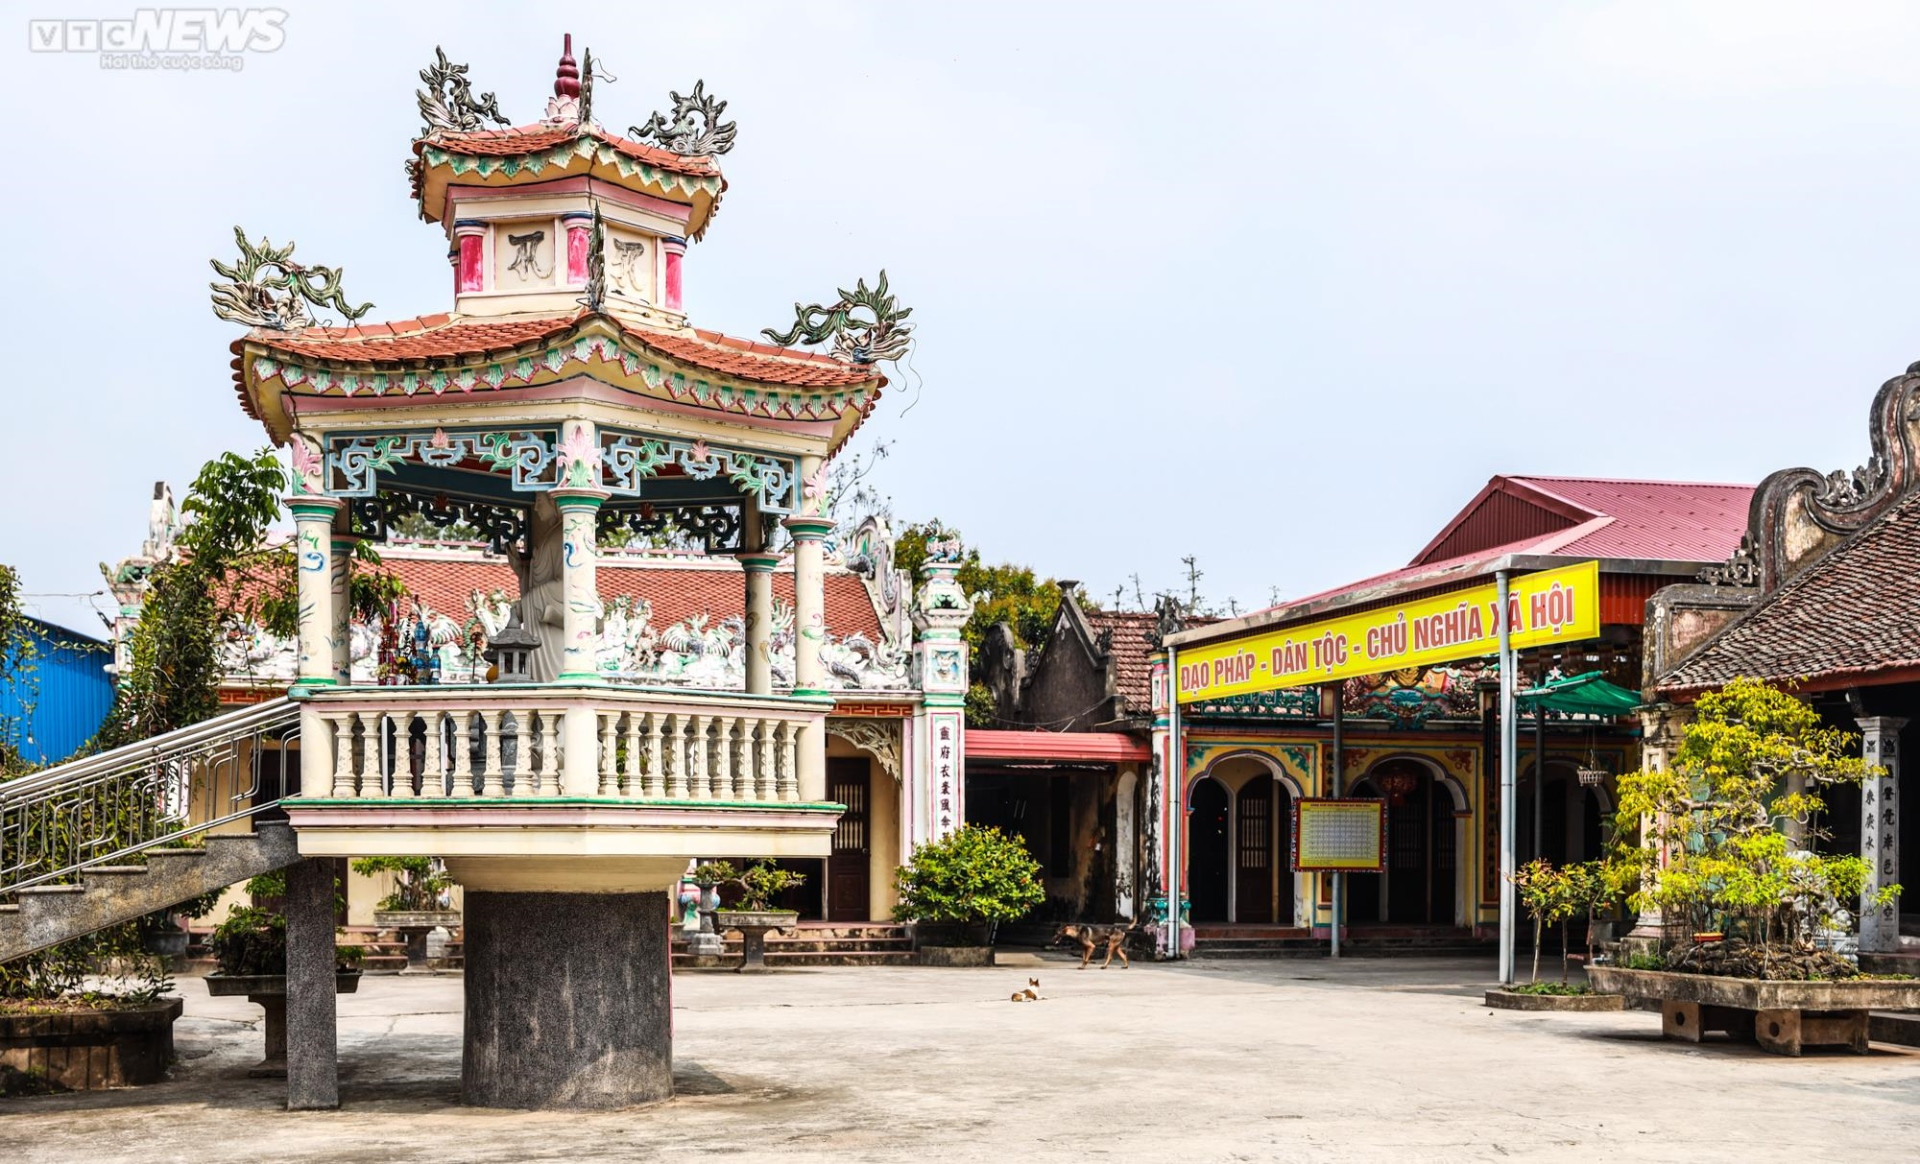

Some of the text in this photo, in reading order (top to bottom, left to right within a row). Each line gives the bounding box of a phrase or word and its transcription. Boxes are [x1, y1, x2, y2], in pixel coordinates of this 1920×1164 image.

[1180, 661, 1210, 696] ĐẠO
[1213, 648, 1256, 687] PHÁP
[1271, 639, 1308, 677] DÂN
[1312, 630, 1348, 674] TỘC
[1366, 612, 1408, 659] CHỦ
[1413, 602, 1484, 651] NGHĨA
[1530, 581, 1575, 635] HỘI
